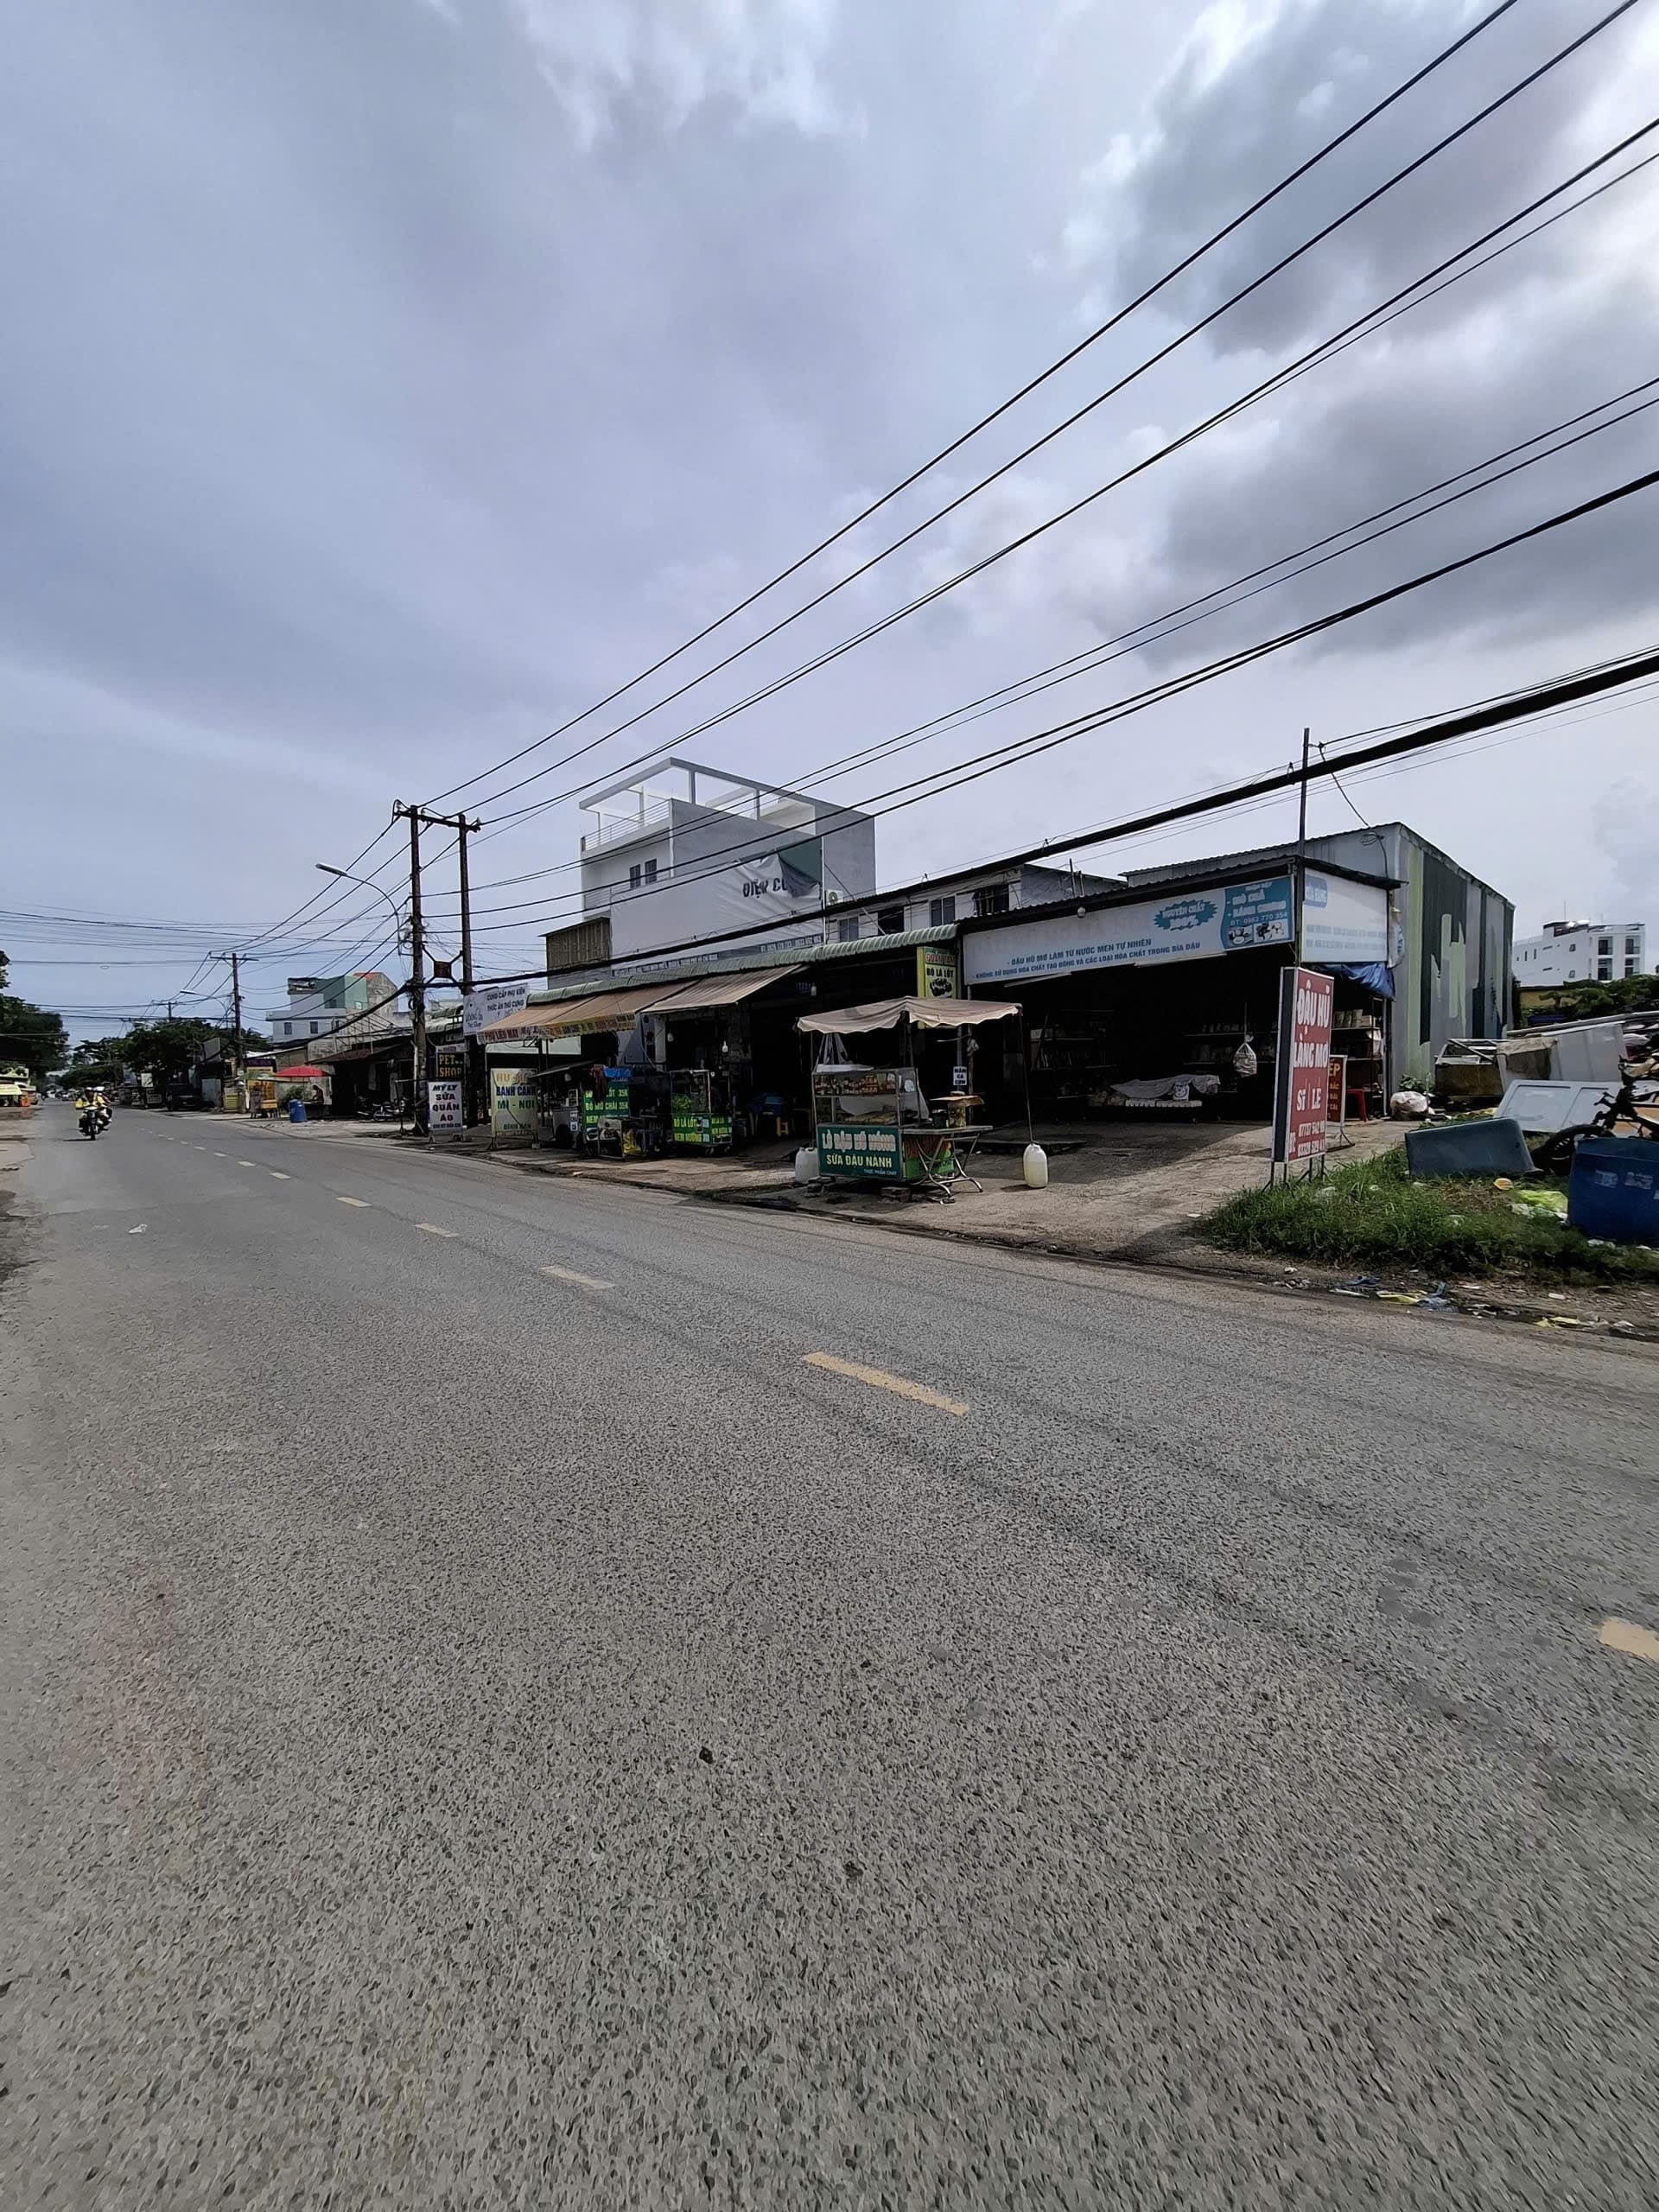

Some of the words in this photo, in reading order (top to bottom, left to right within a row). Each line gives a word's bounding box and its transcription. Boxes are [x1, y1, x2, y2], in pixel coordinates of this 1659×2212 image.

[1170, 915, 1198, 928] 100%
[1097, 944, 1114, 953] MEN
[1127, 938, 1151, 949] NHIÊN
[1147, 946, 1170, 956] TRONG
[439, 1055, 455, 1065] PET
[439, 1068, 462, 1077] SHOP
[845, 1153, 863, 1168] ĐẬU
[866, 1154, 892, 1168] NÀNH
